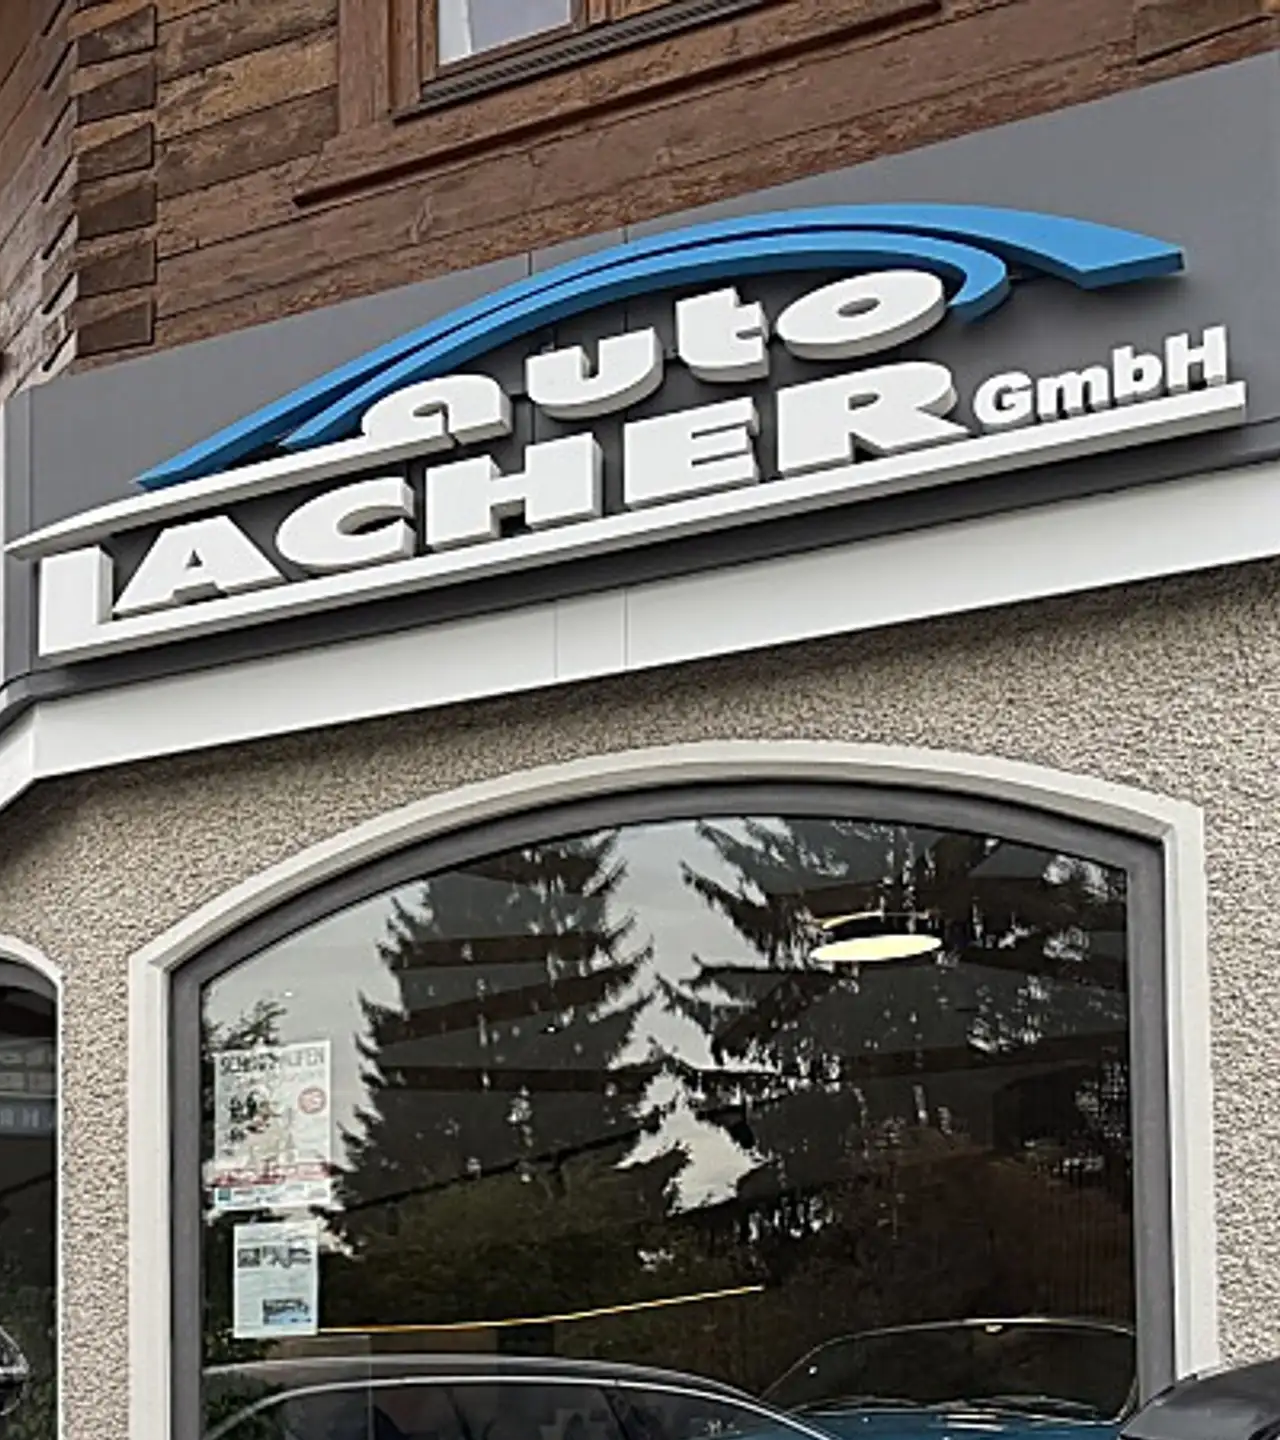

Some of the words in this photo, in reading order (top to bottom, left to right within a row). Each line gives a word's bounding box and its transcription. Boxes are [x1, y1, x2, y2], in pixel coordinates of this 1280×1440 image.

[335, 270, 947, 448] auto
[38, 360, 970, 657] LACHER
[973, 326, 1230, 426] GmbH
